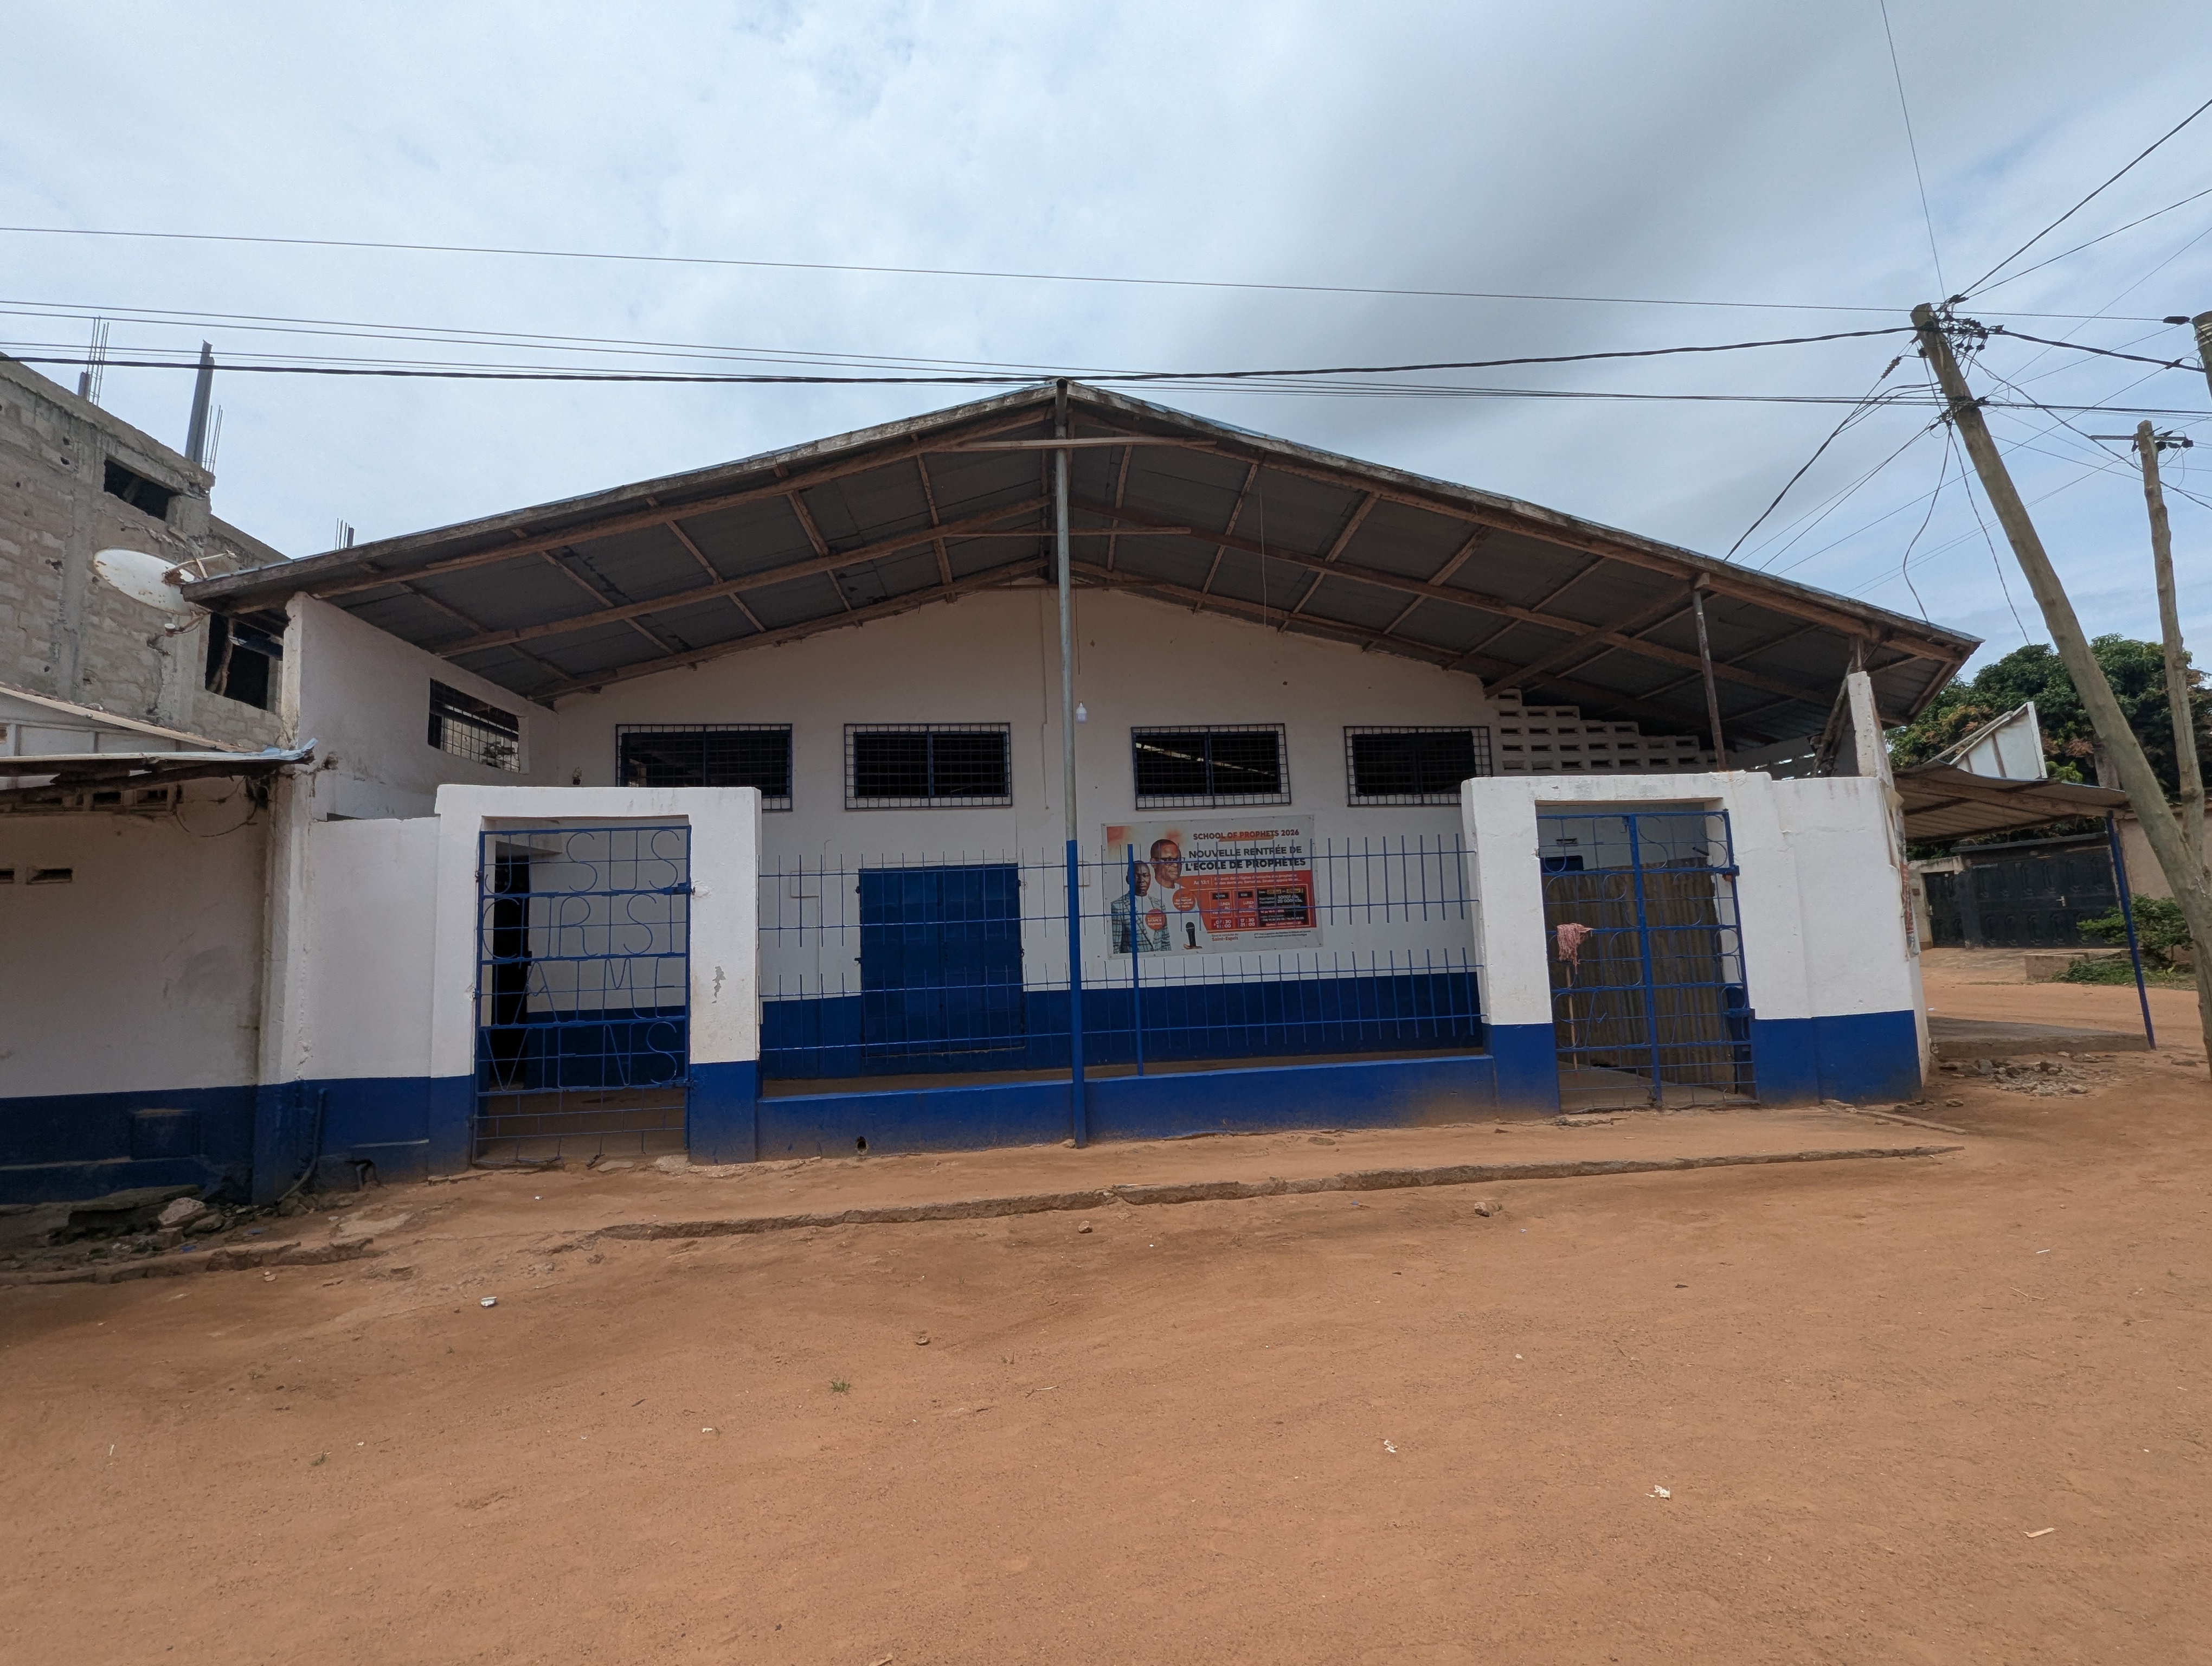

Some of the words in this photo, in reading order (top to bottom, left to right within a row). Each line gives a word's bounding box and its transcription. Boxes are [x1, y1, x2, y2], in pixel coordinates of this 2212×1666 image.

[1193, 832, 1225, 840] SCHOOL
[1239, 830, 1279, 838] PROPHETS
[1189, 848, 1241, 858] NOUVELLE
[1244, 844, 1287, 856] RENTRÉE
[485, 830, 679, 894] JESUS
[1230, 860, 1243, 869] DE
[484, 1021, 678, 1091] VIENS
